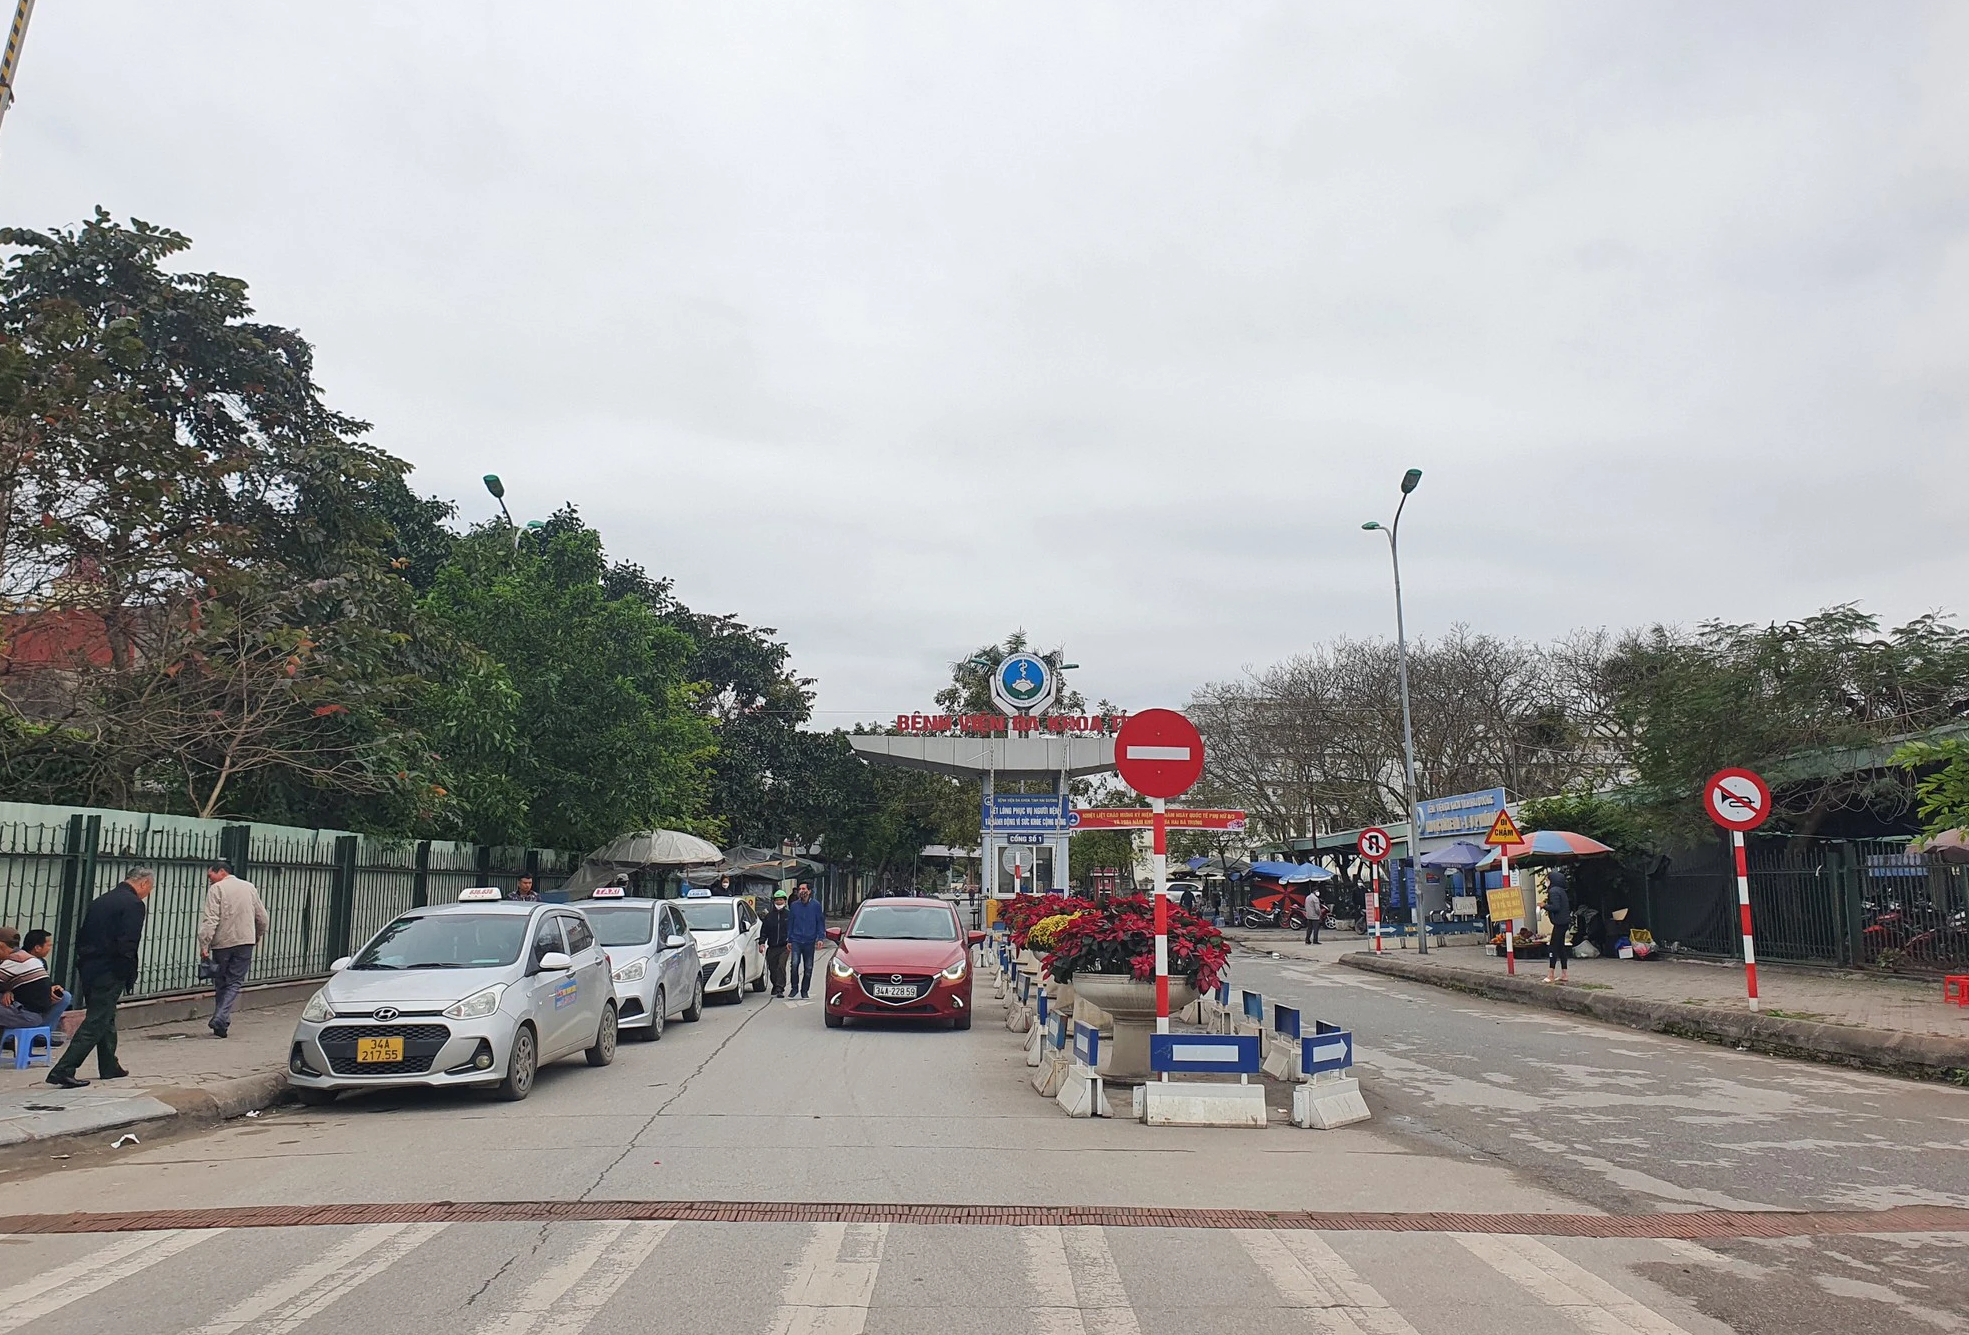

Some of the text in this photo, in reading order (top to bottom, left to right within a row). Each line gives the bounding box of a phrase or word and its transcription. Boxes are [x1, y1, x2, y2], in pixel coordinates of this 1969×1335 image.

[897, 711, 953, 737] BỆNH
[958, 711, 1005, 736] VIỆN
[1012, 715, 1039, 732] ĐA
[1048, 715, 1103, 732] KHOA
[1028, 834, 1036, 842] SỐ
[1495, 828, 1513, 838] CHẬM
[371, 1039, 390, 1049] 34A
[362, 1050, 398, 1060] 217.55
